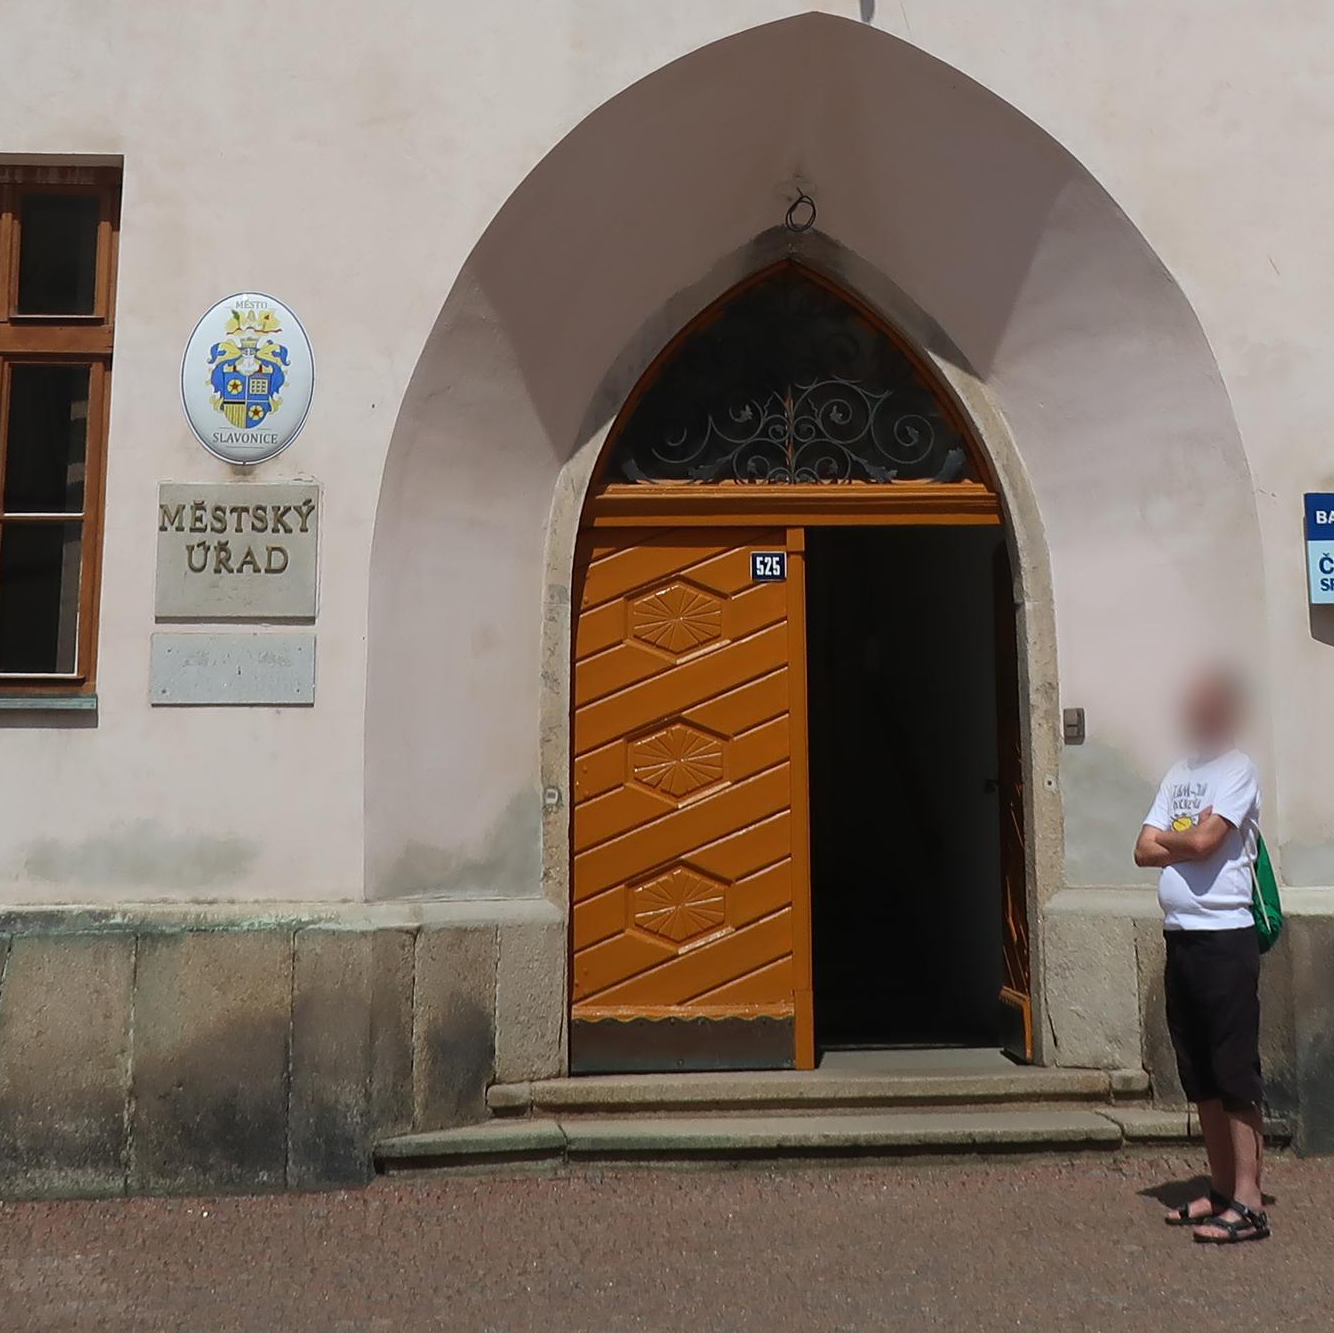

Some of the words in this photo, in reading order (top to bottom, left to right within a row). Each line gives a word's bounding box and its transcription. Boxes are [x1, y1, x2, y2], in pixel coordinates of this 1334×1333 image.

[212, 432, 279, 445] SLAVONICE
[158, 498, 316, 534] MĚSTSKÝ
[185, 540, 289, 575] ÚŘAD
[756, 556, 781, 576] 525
